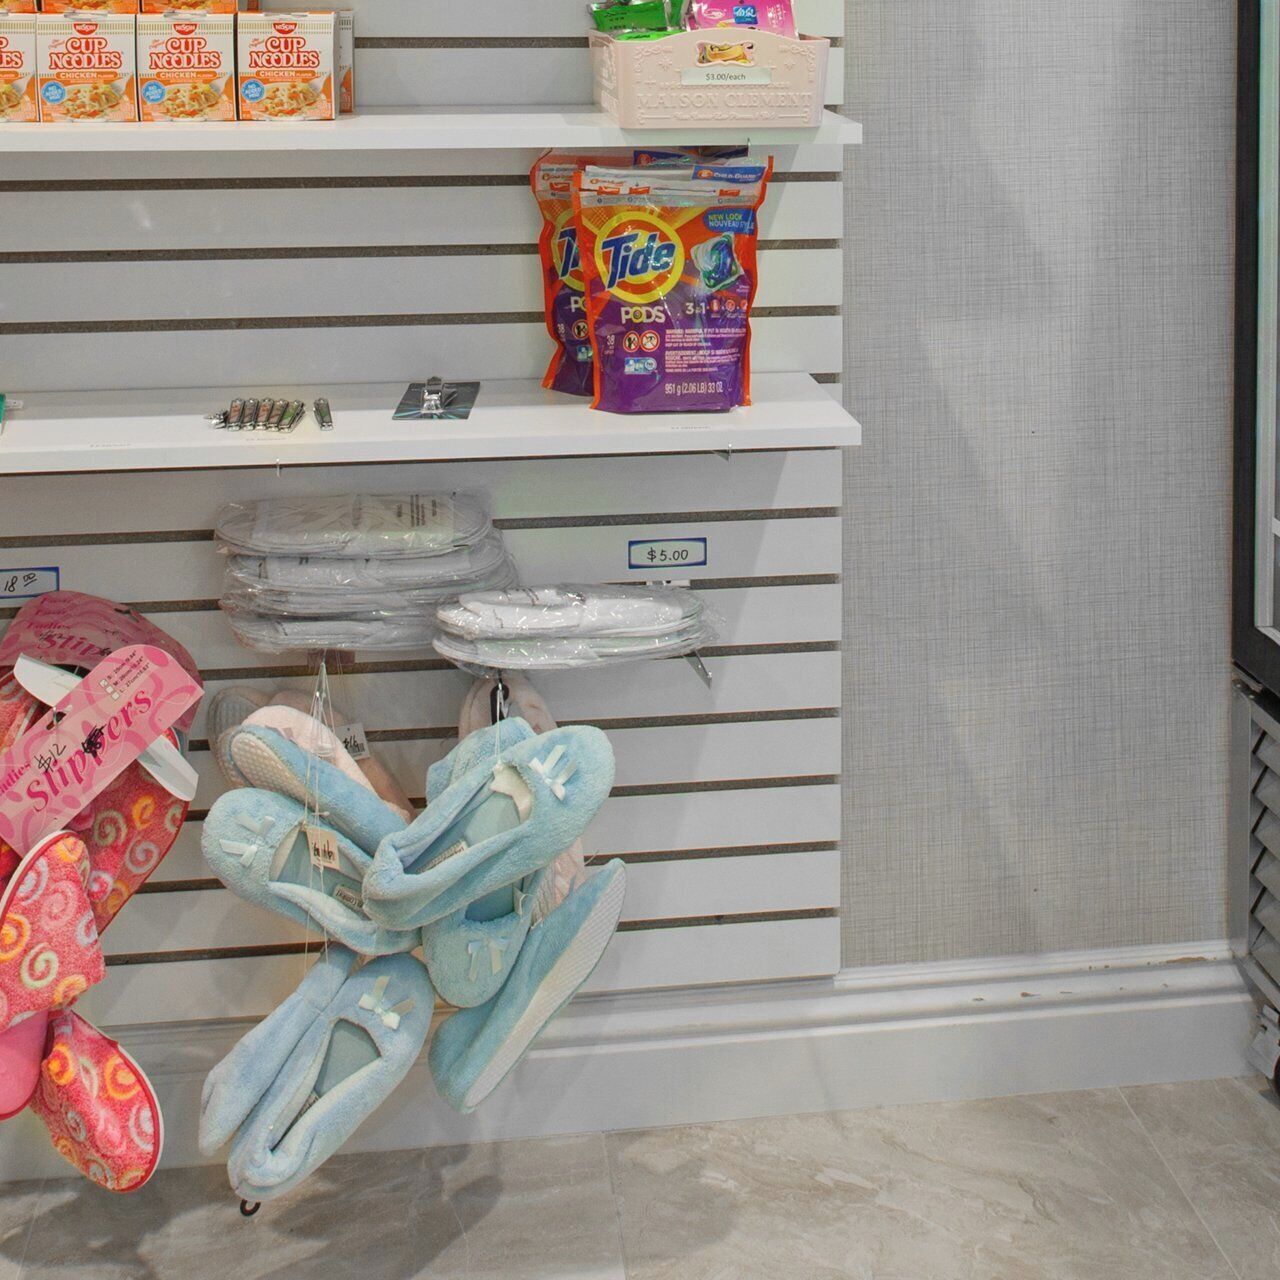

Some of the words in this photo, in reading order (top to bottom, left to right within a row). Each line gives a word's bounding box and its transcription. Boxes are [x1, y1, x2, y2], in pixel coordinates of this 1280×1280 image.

[166, 37, 207, 53] CUP
[265, 36, 306, 52] CUP
[149, 52, 221, 69] NOODLES
[249, 51, 320, 69] NOODLES
[259, 70, 295, 78] CHICKEN
[705, 71, 746, 82] $3.00/each
[601, 232, 676, 290] Tide
[621, 305, 666, 324] PODS
[665, 384, 676, 394] 951
[708, 382, 715, 392] 33
[646, 546, 690, 564] $5.00
[4, 576, 16, 592] 18
[26, 690, 152, 812] Slippers
[34, 743, 68, 773] $12
